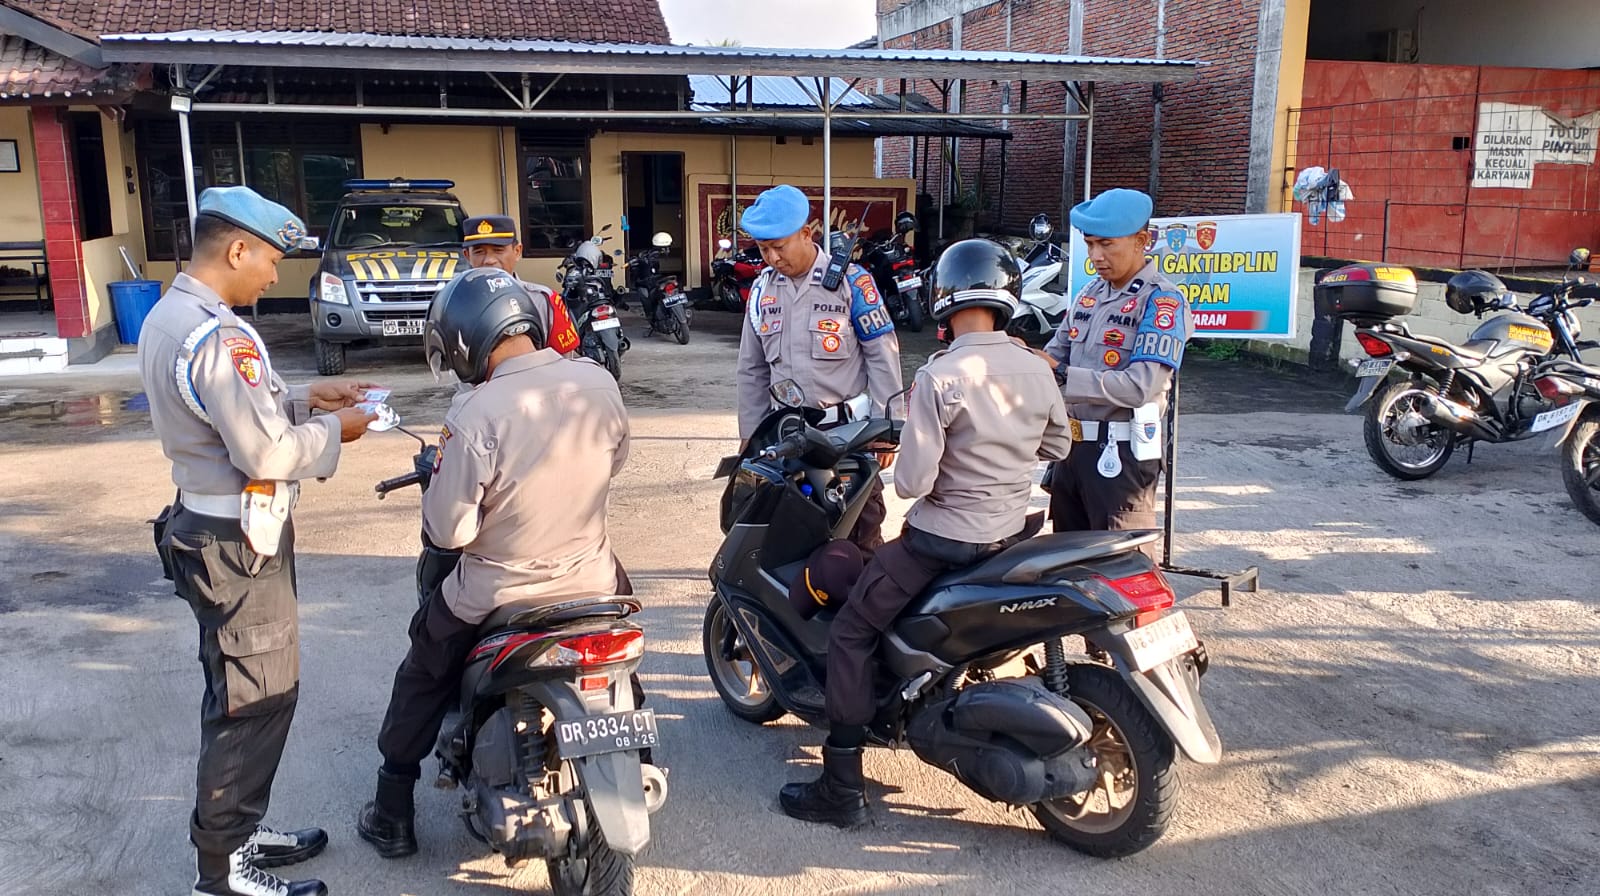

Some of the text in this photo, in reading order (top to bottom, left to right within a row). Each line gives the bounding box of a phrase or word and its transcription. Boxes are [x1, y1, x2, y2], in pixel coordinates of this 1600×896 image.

[1483, 135, 1532, 146] DILARANG
[1489, 148, 1525, 157] MASUK
[1485, 159, 1527, 169] KECUALI
[1477, 171, 1531, 180] KARYAWAN
[346, 251, 460, 261] POLISI
[1163, 251, 1278, 274] GAKTIBPLIN
[1177, 283, 1231, 304] OPAM
[813, 303, 846, 314] POLRI
[1132, 332, 1182, 363] PROV
[999, 597, 1058, 613] NMAX
[561, 712, 652, 743] DR 3334 CT
